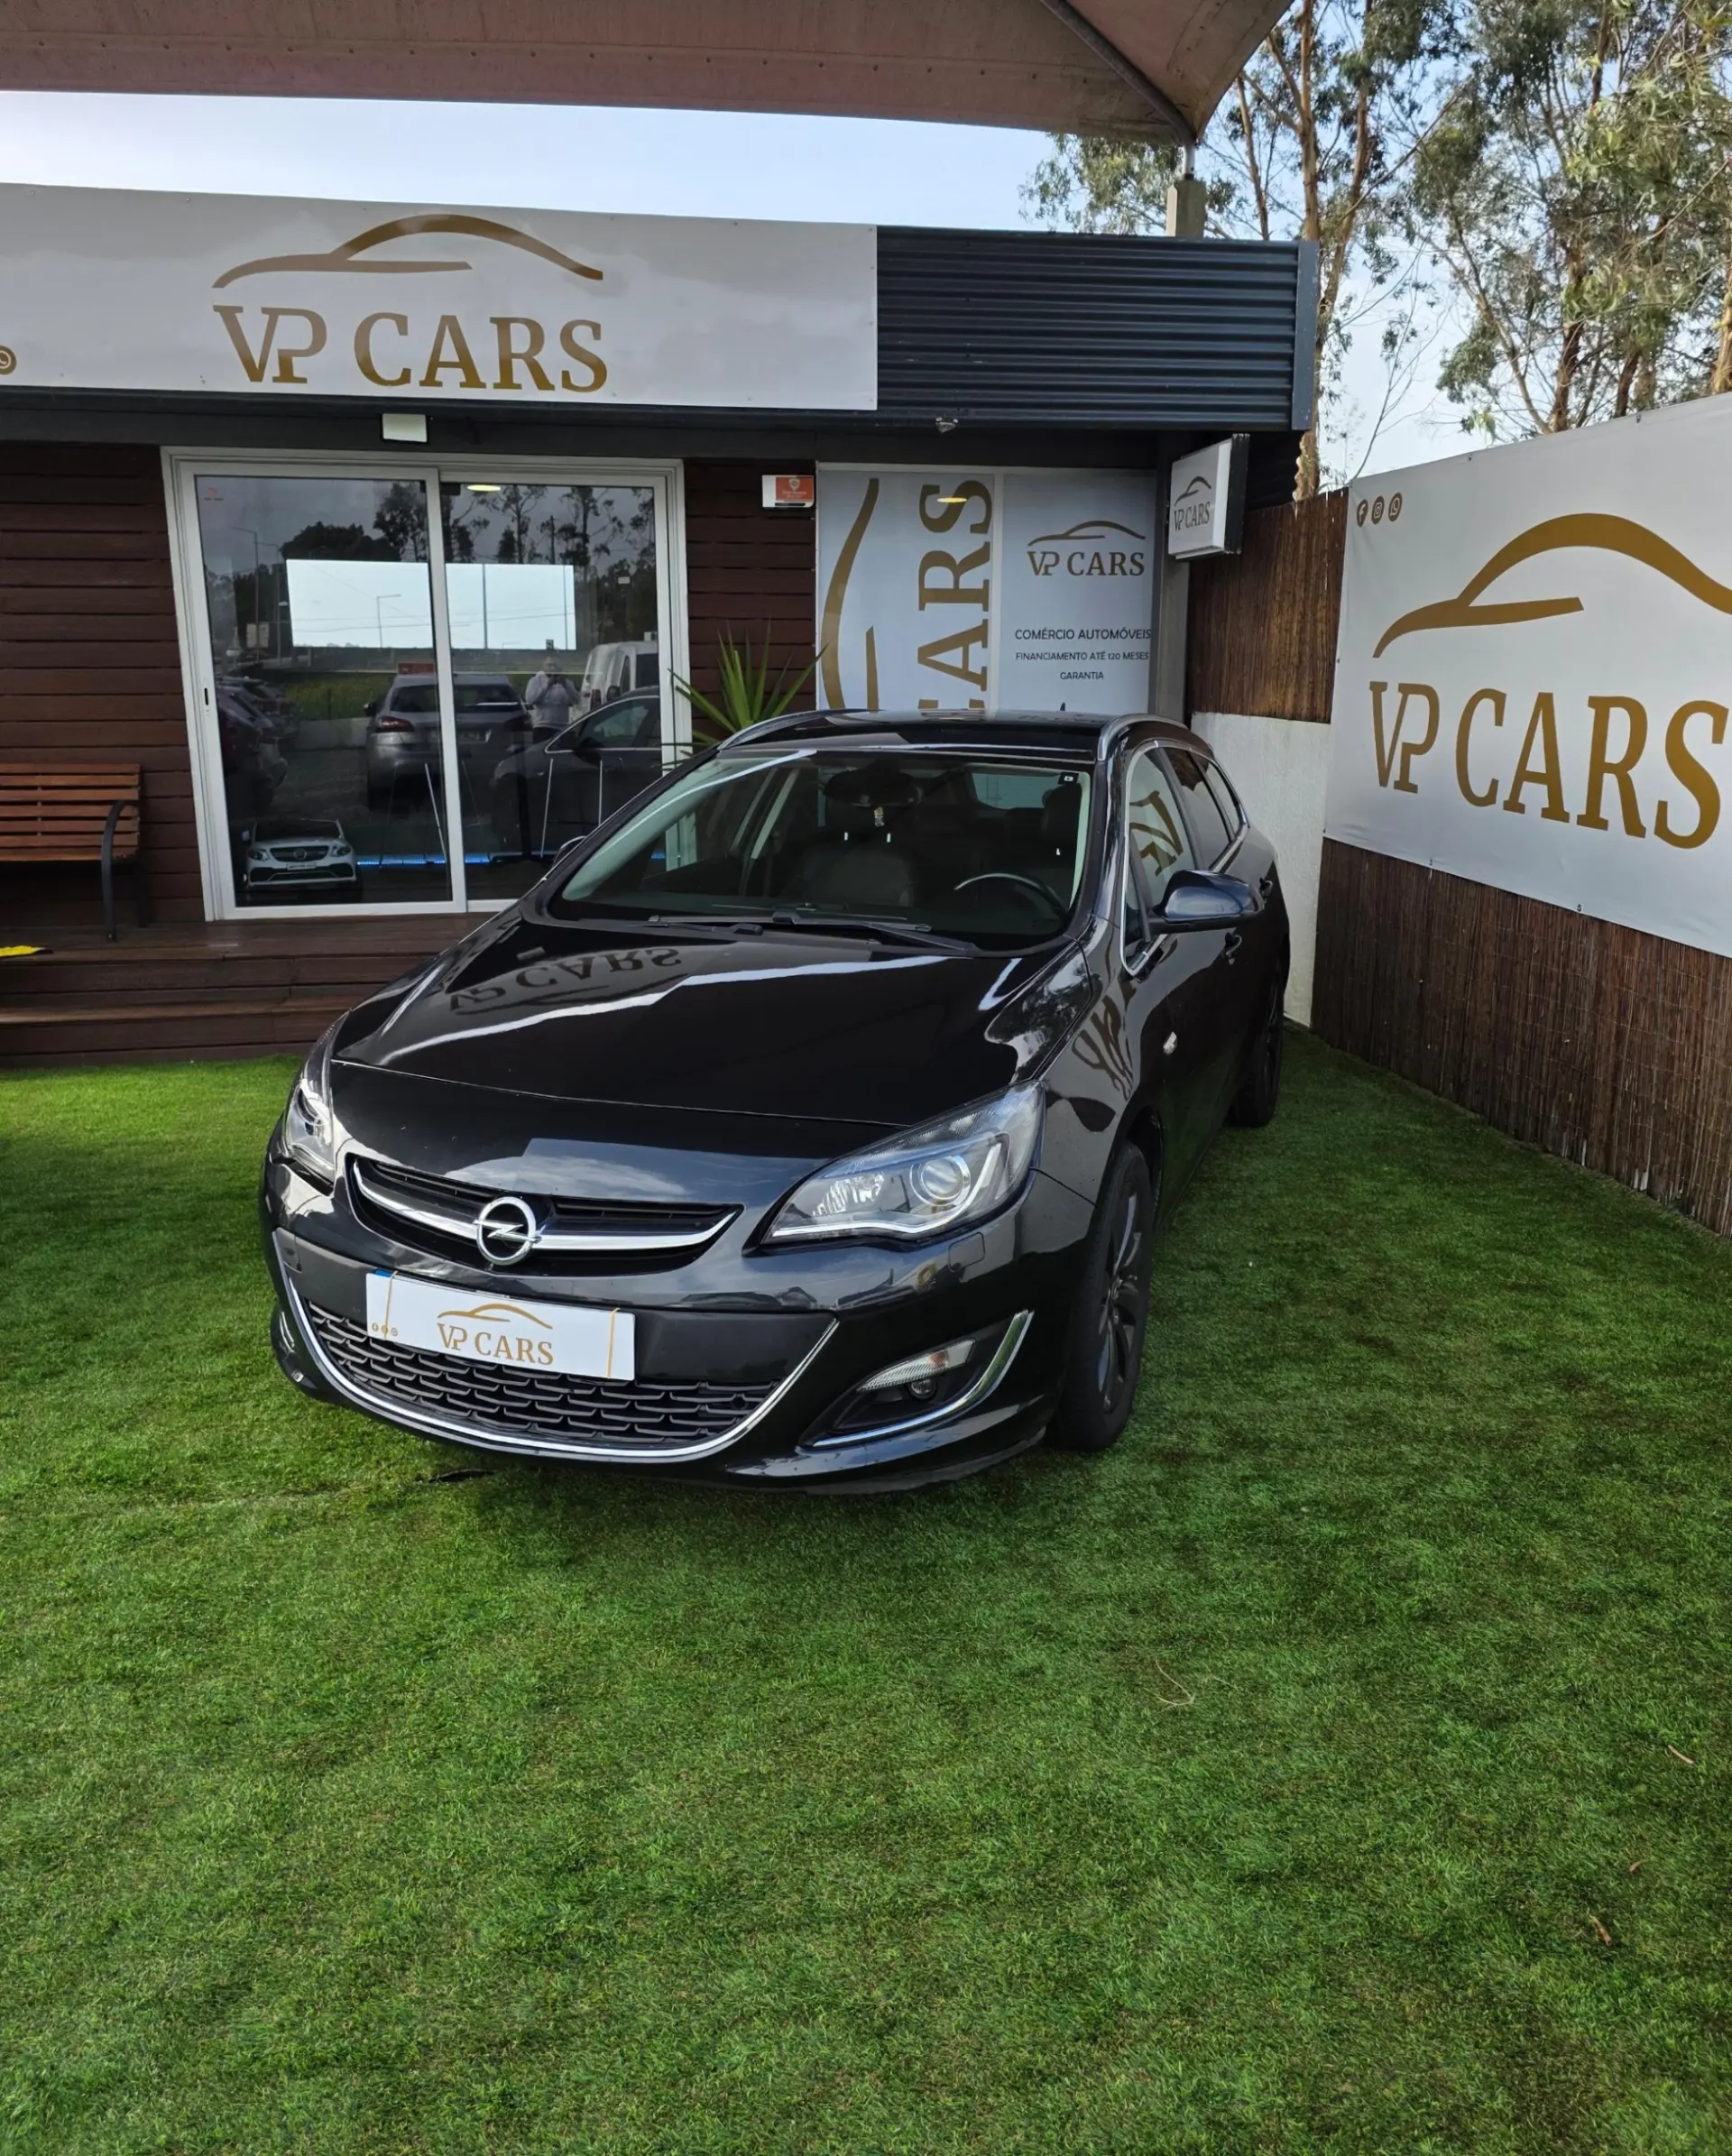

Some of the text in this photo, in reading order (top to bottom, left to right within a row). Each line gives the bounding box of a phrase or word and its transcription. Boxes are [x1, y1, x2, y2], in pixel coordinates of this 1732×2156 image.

[212, 304, 609, 393] VP CARS
[1174, 501, 1211, 531] VP CARS
[1027, 550, 1146, 576] VP CARS
[1015, 626, 1152, 640] COMÉRCIO AUTOMÓVEIS
[1015, 650, 1149, 661] FINANCIAMENTO ATÉ 120 MESES
[1059, 671, 1104, 680] GARANTIA
[1368, 680, 1730, 850] VP CARS
[437, 1322, 555, 1367] VP CARS
